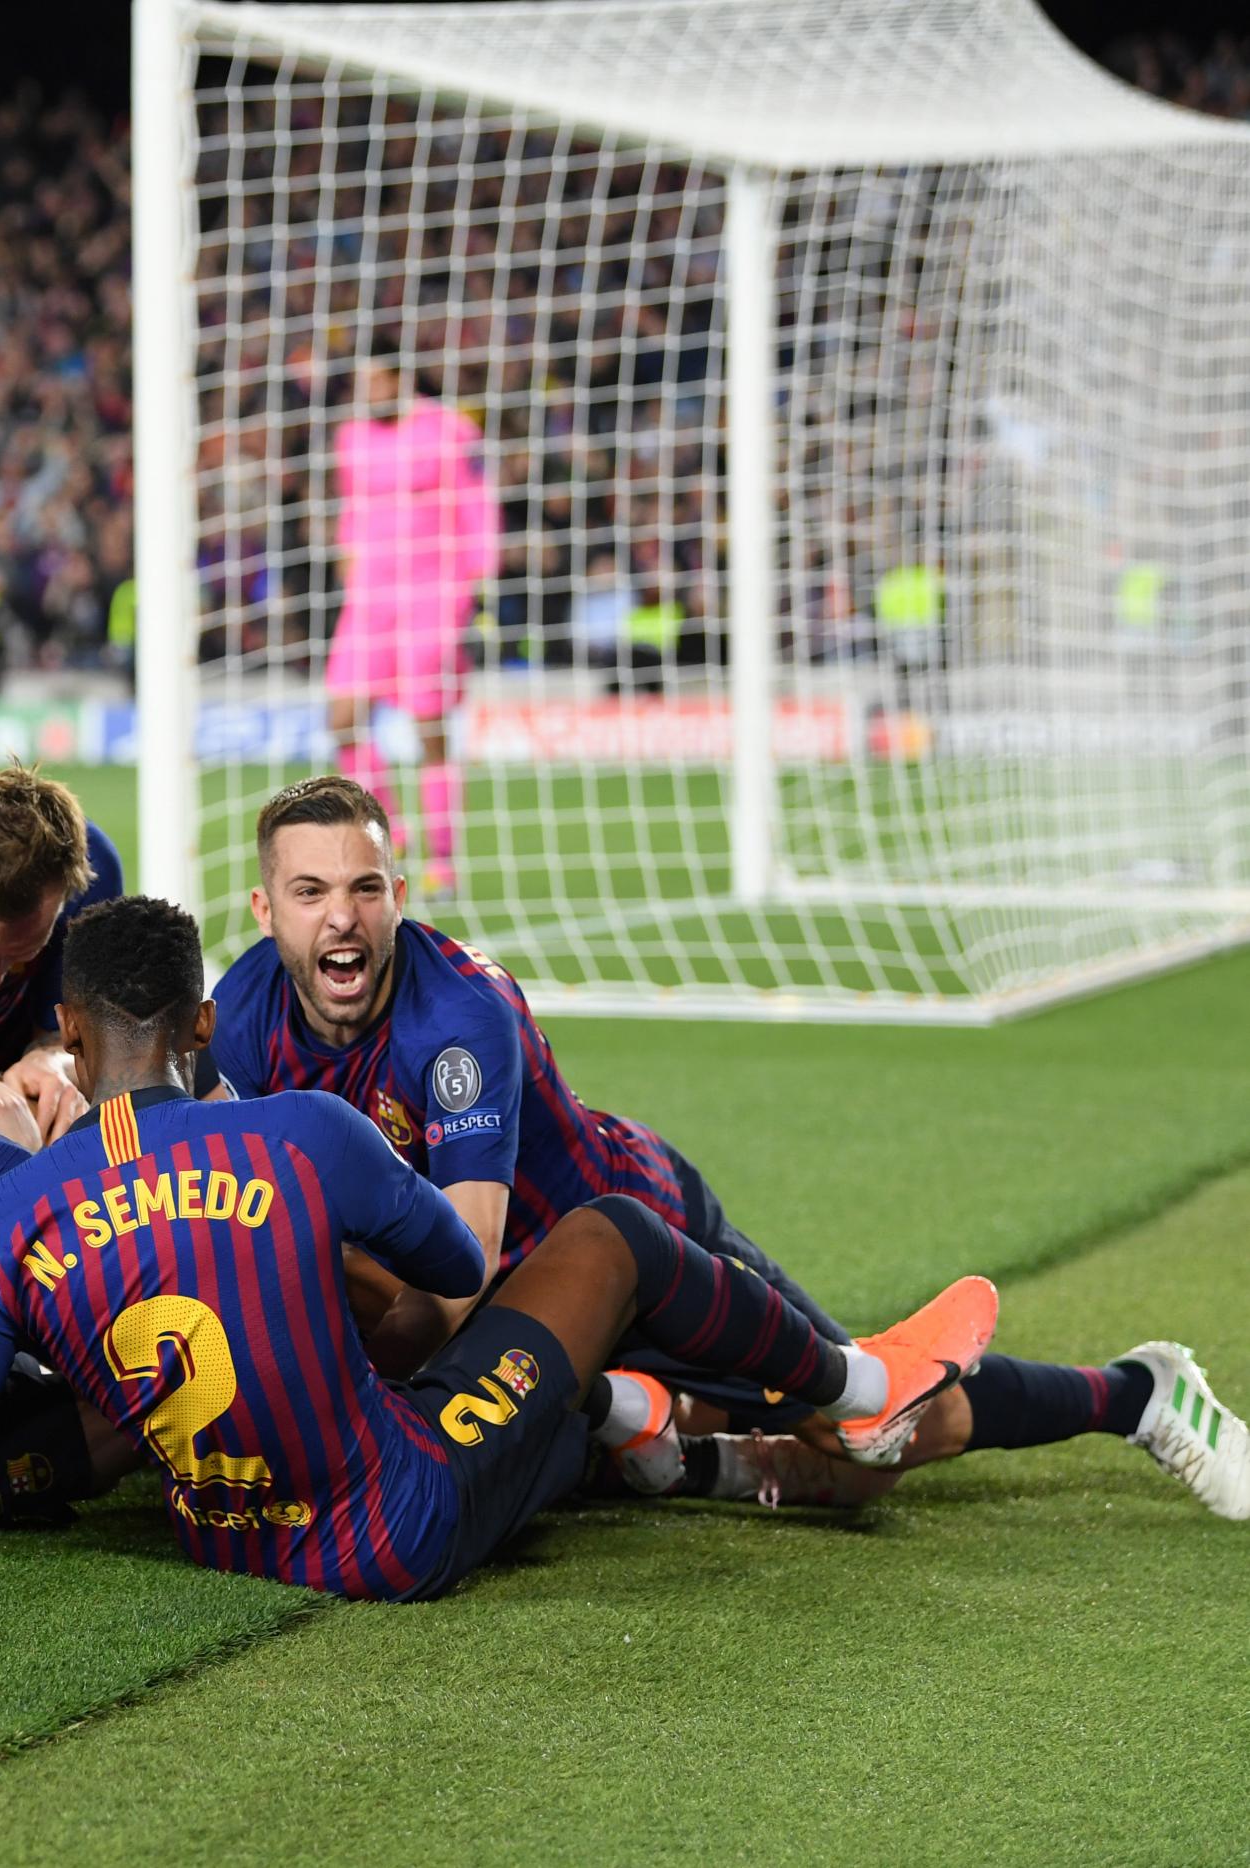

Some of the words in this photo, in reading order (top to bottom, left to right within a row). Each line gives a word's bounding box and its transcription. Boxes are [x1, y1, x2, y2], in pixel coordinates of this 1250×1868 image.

[450, 1078, 463, 1096] 5
[444, 1113, 502, 1135] RESPECT
[22, 1239, 78, 1292] N.
[72, 1169, 275, 1249] SEMEDO
[103, 1294, 273, 1490] 2
[439, 1375, 519, 1447] 2
